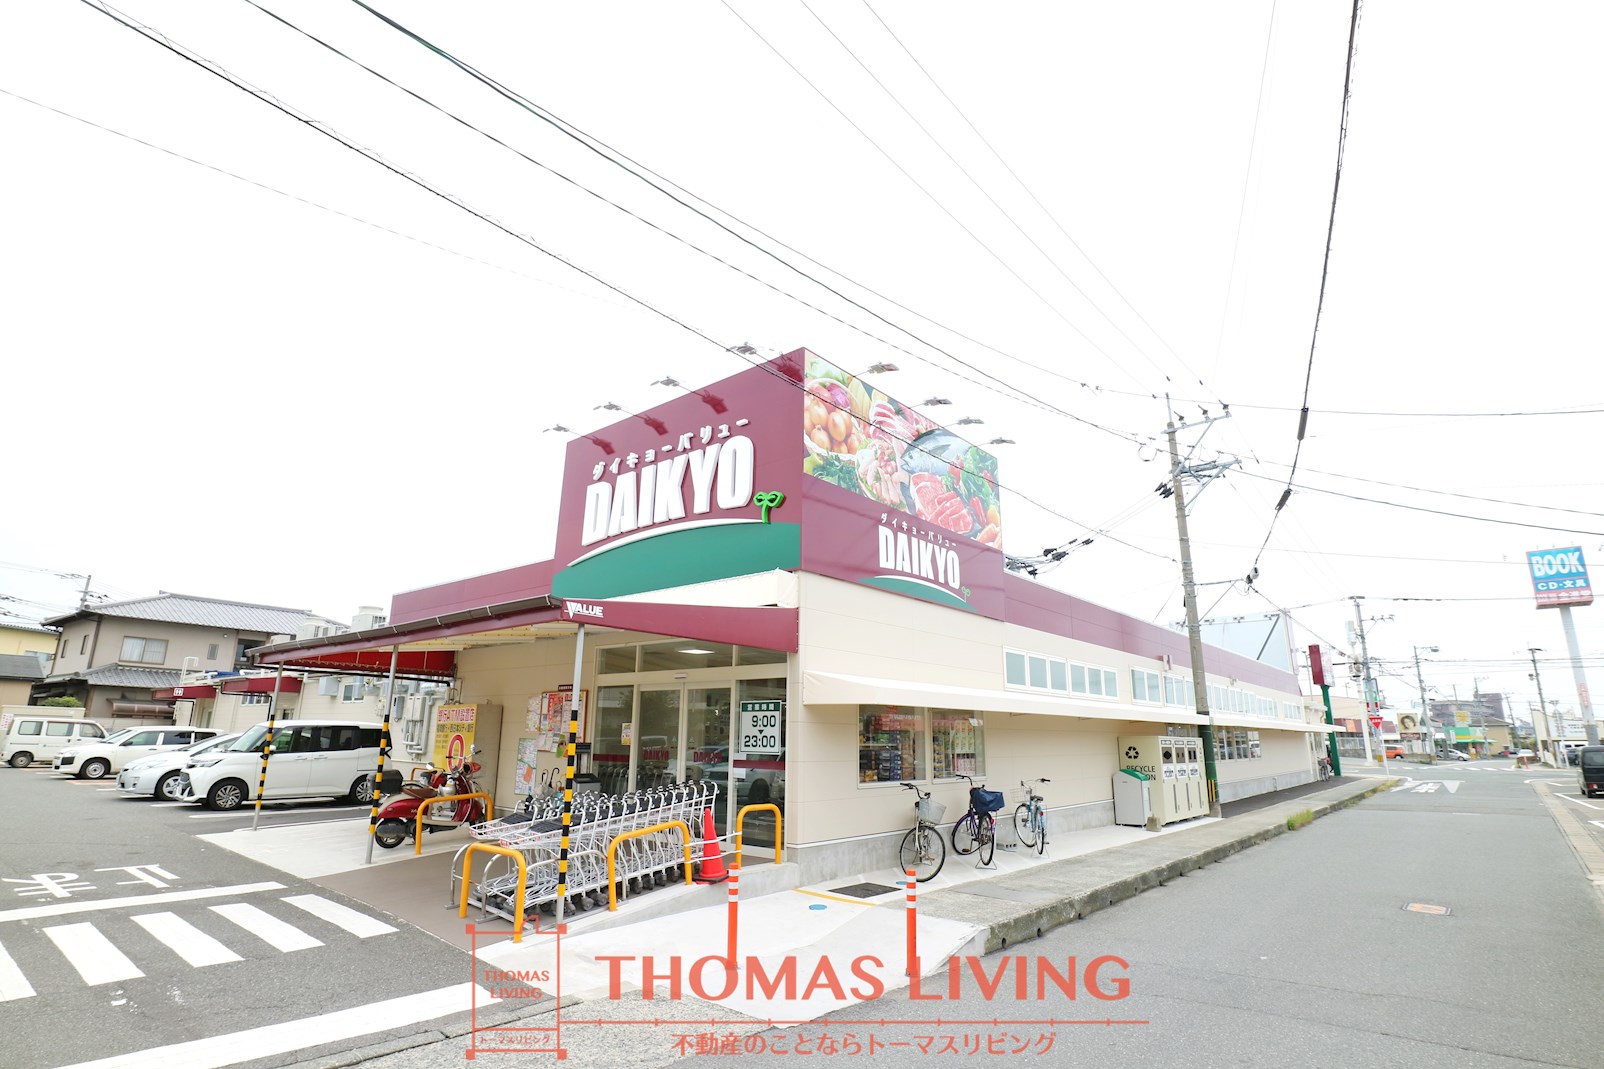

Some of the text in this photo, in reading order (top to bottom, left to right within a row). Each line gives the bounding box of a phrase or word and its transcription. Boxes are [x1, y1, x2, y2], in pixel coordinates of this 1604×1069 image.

[593, 419, 749, 481] ダイキョーバリュー
[582, 435, 754, 547] DAIKYO
[880, 512, 957, 547] ダイキョーバリュー
[878, 525, 961, 590] DAIKYO
[1531, 552, 1584, 577] BOOK
[565, 601, 604, 619] VALUE
[752, 715, 776, 727] 9:00
[744, 735, 776, 747] 23:00
